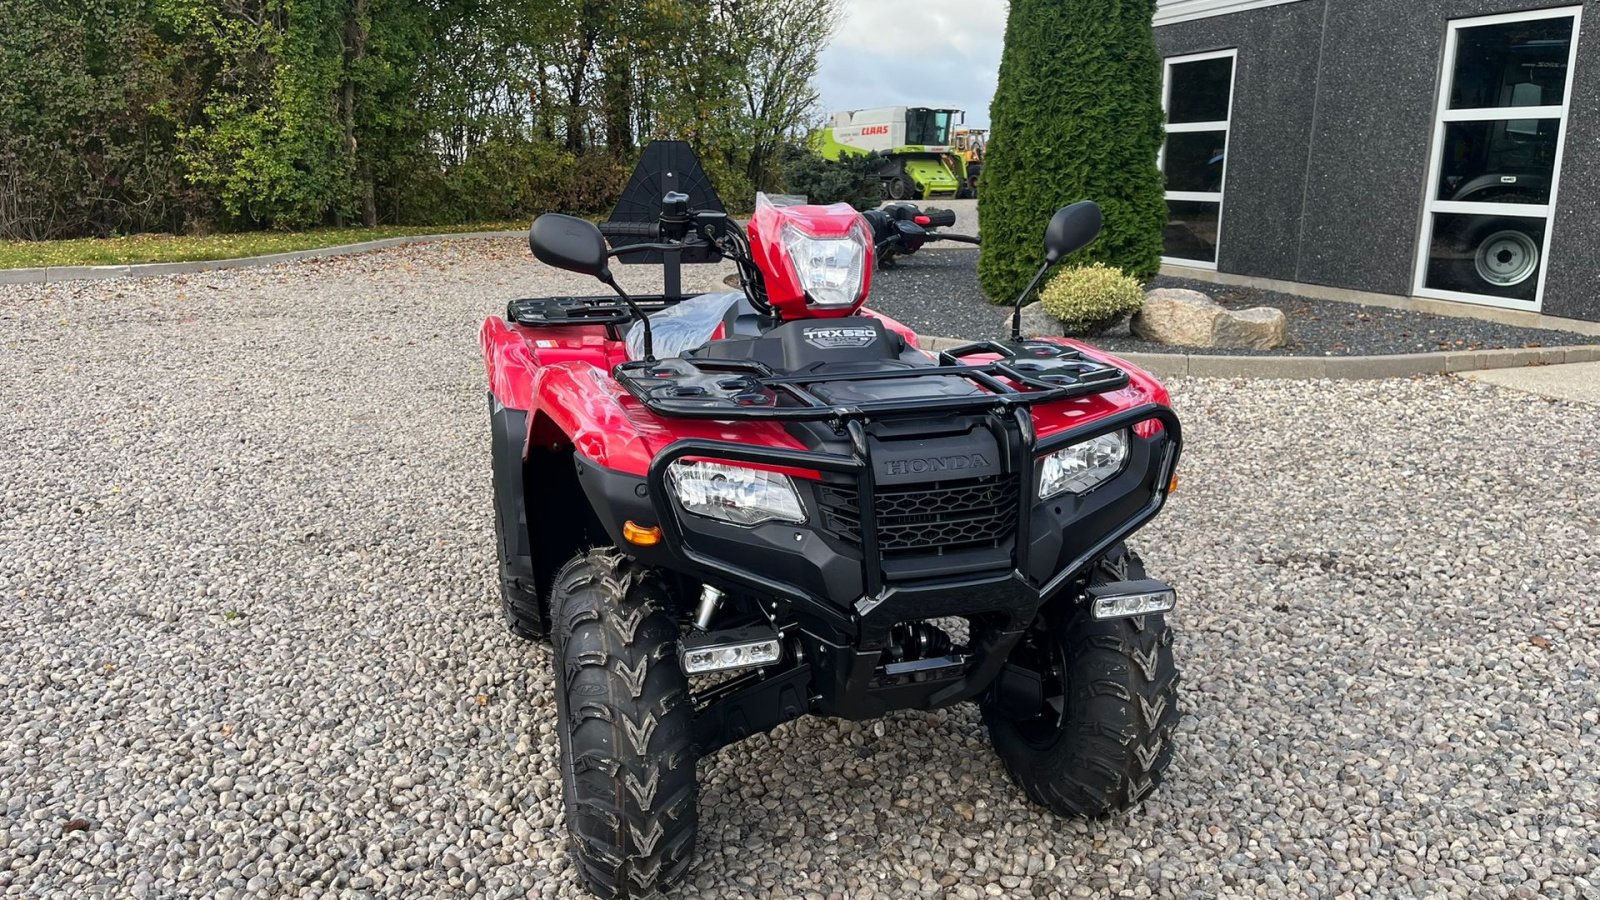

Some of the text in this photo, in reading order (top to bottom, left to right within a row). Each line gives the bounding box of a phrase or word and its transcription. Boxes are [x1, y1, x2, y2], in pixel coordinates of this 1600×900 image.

[862, 126, 888, 136] CLAAS
[803, 329, 877, 339] TRX520
[884, 453, 990, 476] HONDA
